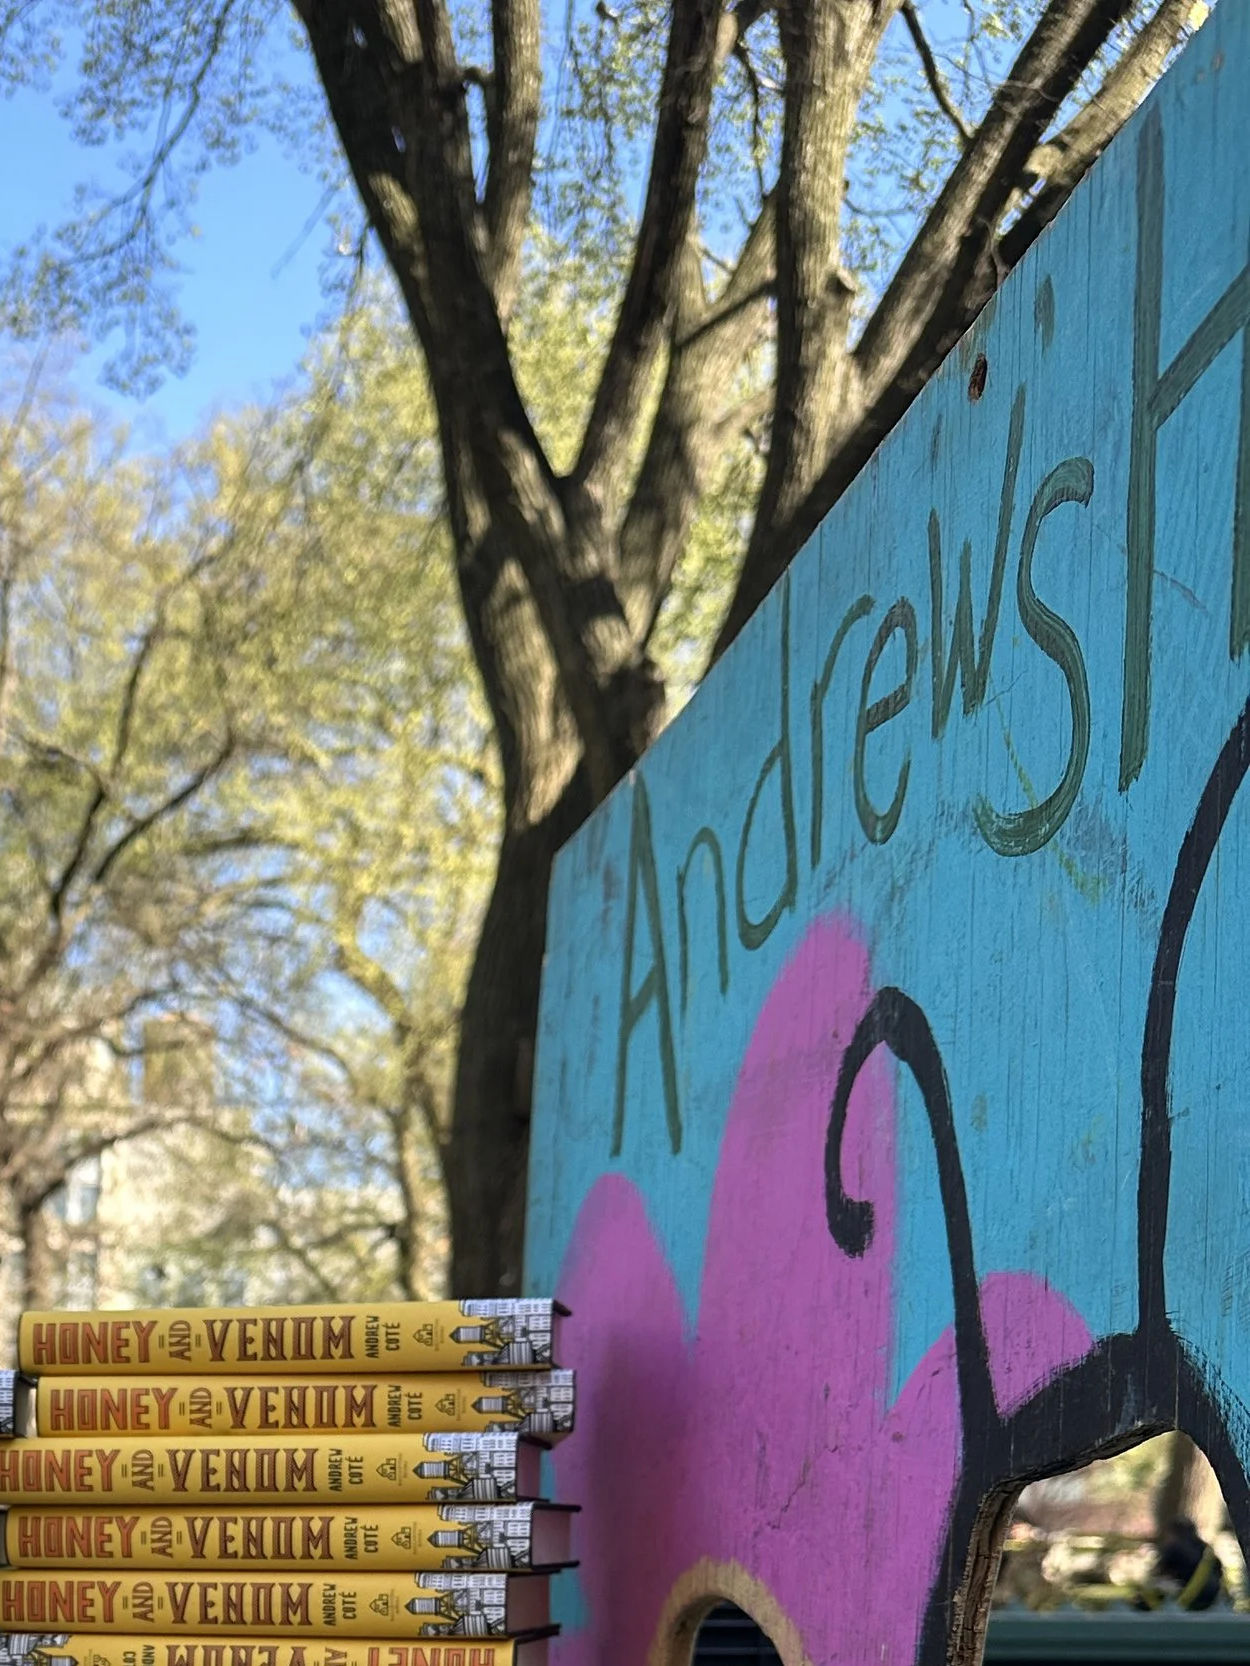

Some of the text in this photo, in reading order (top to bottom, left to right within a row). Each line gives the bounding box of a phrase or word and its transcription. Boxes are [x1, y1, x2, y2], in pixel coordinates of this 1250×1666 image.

[34, 1316, 355, 1364] HONEY AND VENOM
[365, 1316, 379, 1359] ANDREW
[383, 1323, 400, 1351] COTÉ
[50, 1385, 378, 1431] HONEY AND VENOM
[388, 1385, 401, 1428] ANDREW
[405, 1393, 422, 1420] COTÉ
[131, 1450, 155, 1490] AND
[167, 1449, 318, 1492] VENOM
[328, 1449, 342, 1491] ANDREW
[346, 1457, 363, 1485] COTÉ
[18, 1515, 334, 1560] HONEY AND VENOM
[344, 1517, 358, 1560] ANDREW
[361, 1525, 378, 1553] COTÉ
[2, 1580, 313, 1626] HONEY AND VENOM
[322, 1584, 337, 1627] ANDREW
[339, 1592, 357, 1620] COTÉ
